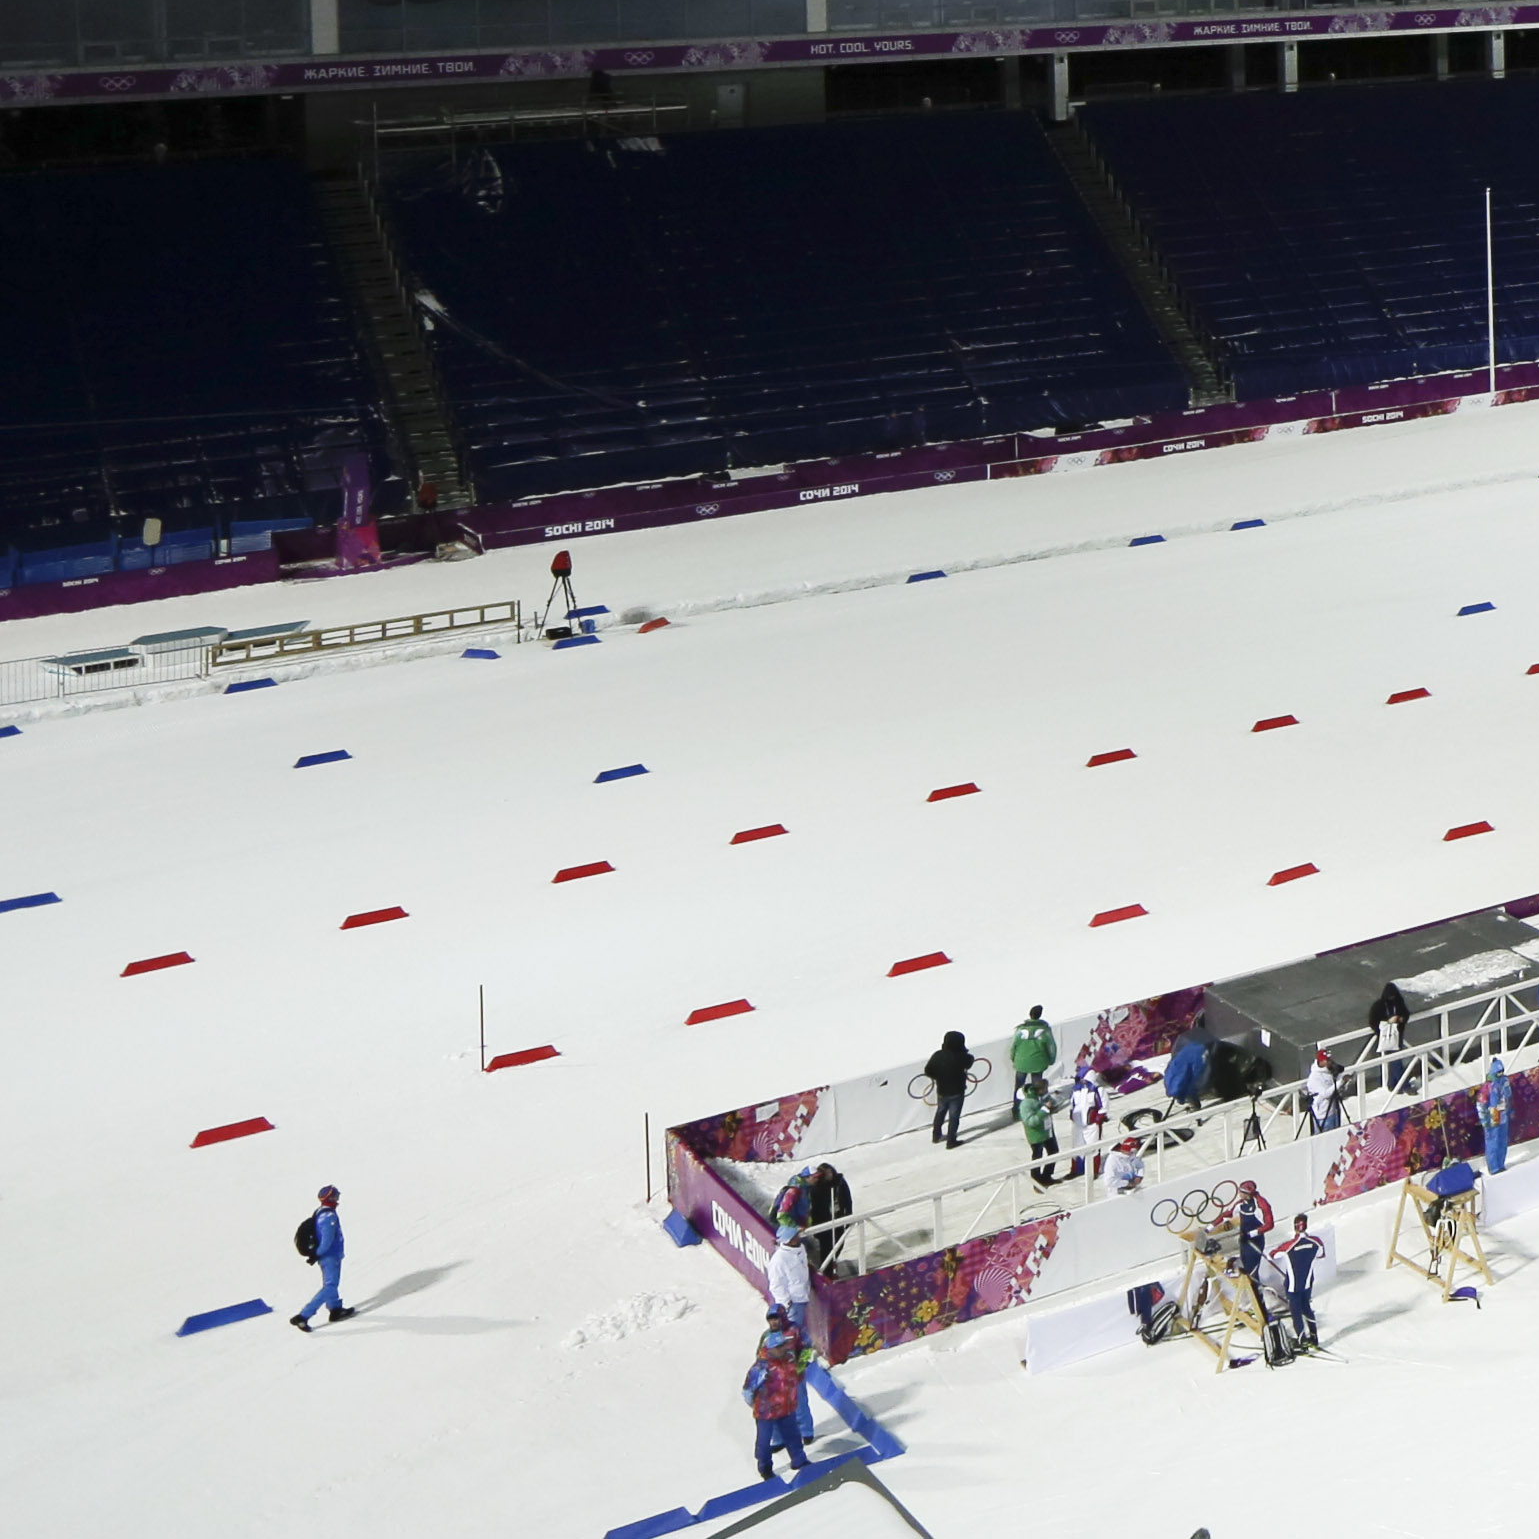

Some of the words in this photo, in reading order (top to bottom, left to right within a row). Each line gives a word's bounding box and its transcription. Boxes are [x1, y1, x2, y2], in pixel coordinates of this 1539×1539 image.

[811, 44, 836, 54] HOT.
[840, 42, 871, 53] COOL.
[874, 40, 915, 51] YOURS.
[304, 66, 369, 80] ЖАРКИЕ.
[373, 63, 432, 77] ЗИМНИЕ.
[800, 488, 831, 501] СОЧИ
[832, 483, 860, 496] 2014
[544, 522, 582, 538] SOCHI
[584, 518, 615, 532] 2014
[712, 1200, 744, 1253] СОЧИ
[744, 1229, 769, 1274] 2014
